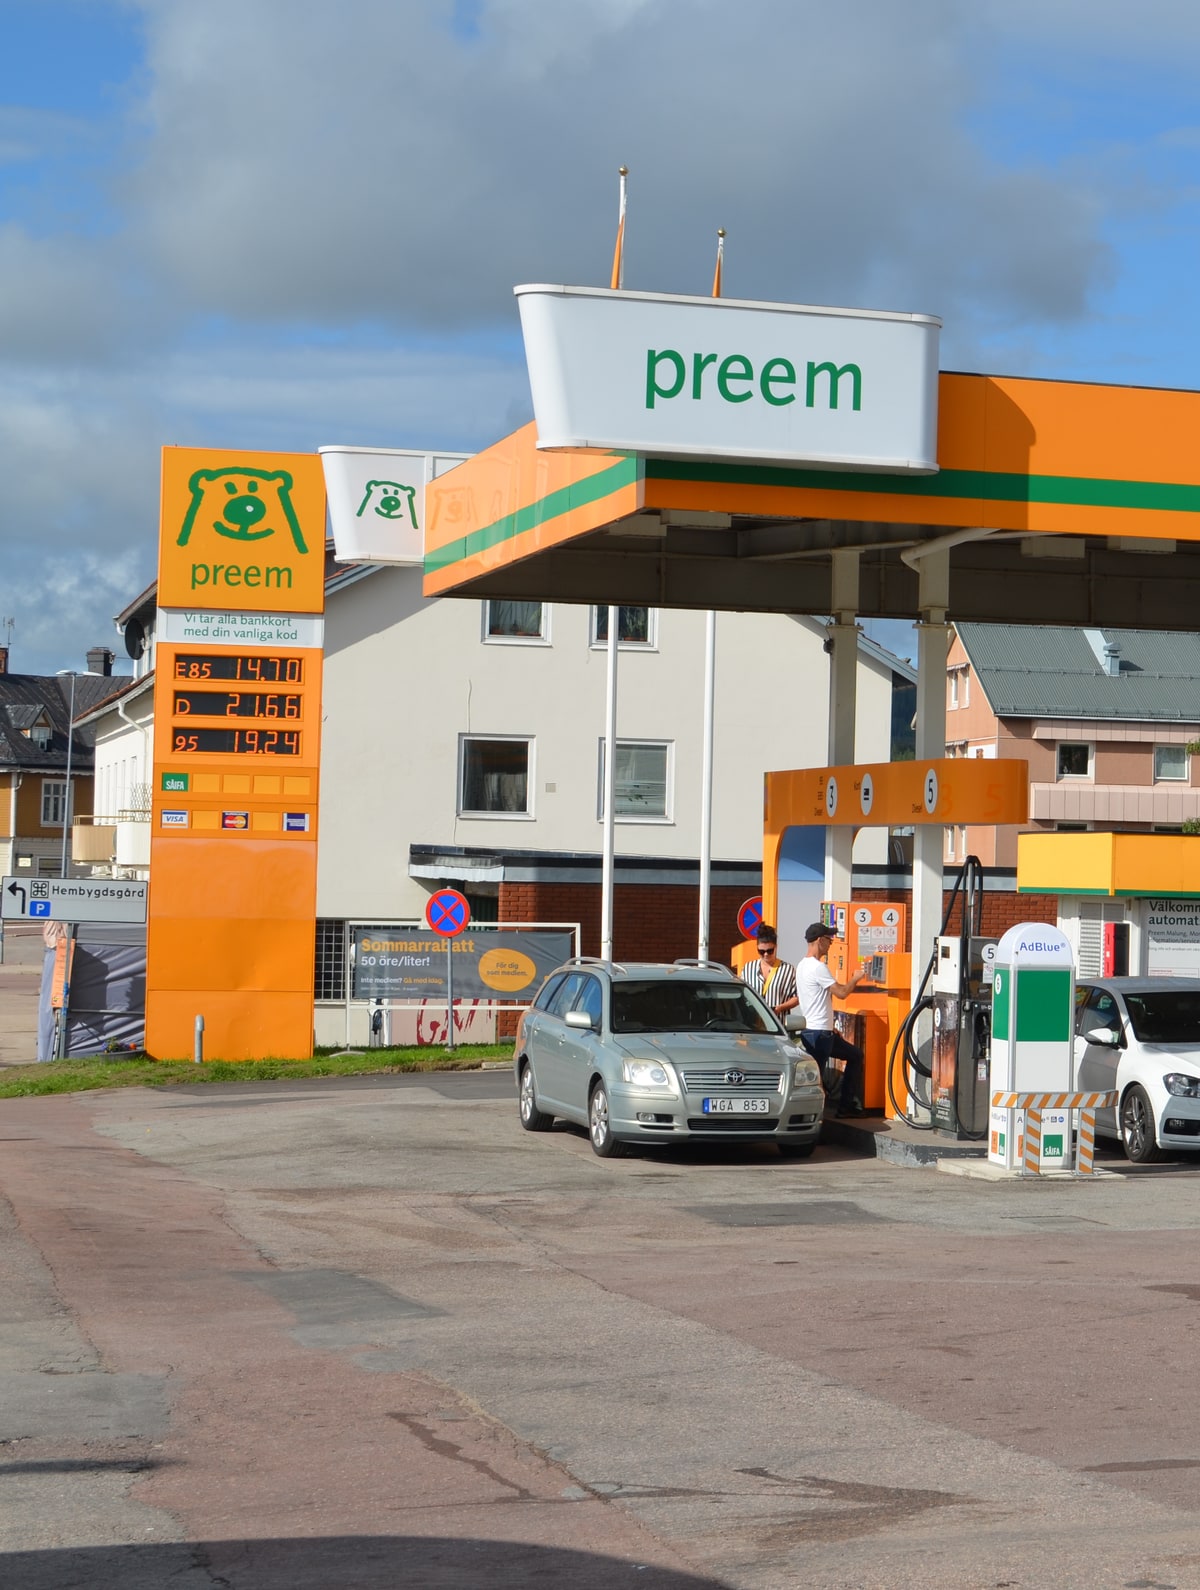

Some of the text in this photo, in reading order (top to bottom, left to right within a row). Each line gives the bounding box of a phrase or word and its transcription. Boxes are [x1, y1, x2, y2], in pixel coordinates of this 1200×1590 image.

[646, 348, 863, 412] preem
[191, 563, 293, 590] preem
[184, 612, 292, 627] Vi tar alla bankkort
[184, 627, 298, 642] med din vanliga kod
[175, 658, 300, 682] E85 14.70
[175, 693, 299, 718] D 21.66
[175, 730, 298, 754] 95 19.24
[828, 785, 835, 809] 3
[928, 778, 934, 804] 5
[165, 815, 184, 823] VISA
[51, 885, 145, 899] Hembygdsgård
[859, 911, 894, 923] 3 4
[361, 937, 475, 953] Sommarrabatt
[360, 955, 430, 967] 50 öre/liter!
[987, 947, 995, 960] 5
[711, 1100, 766, 1111] WGA 853
